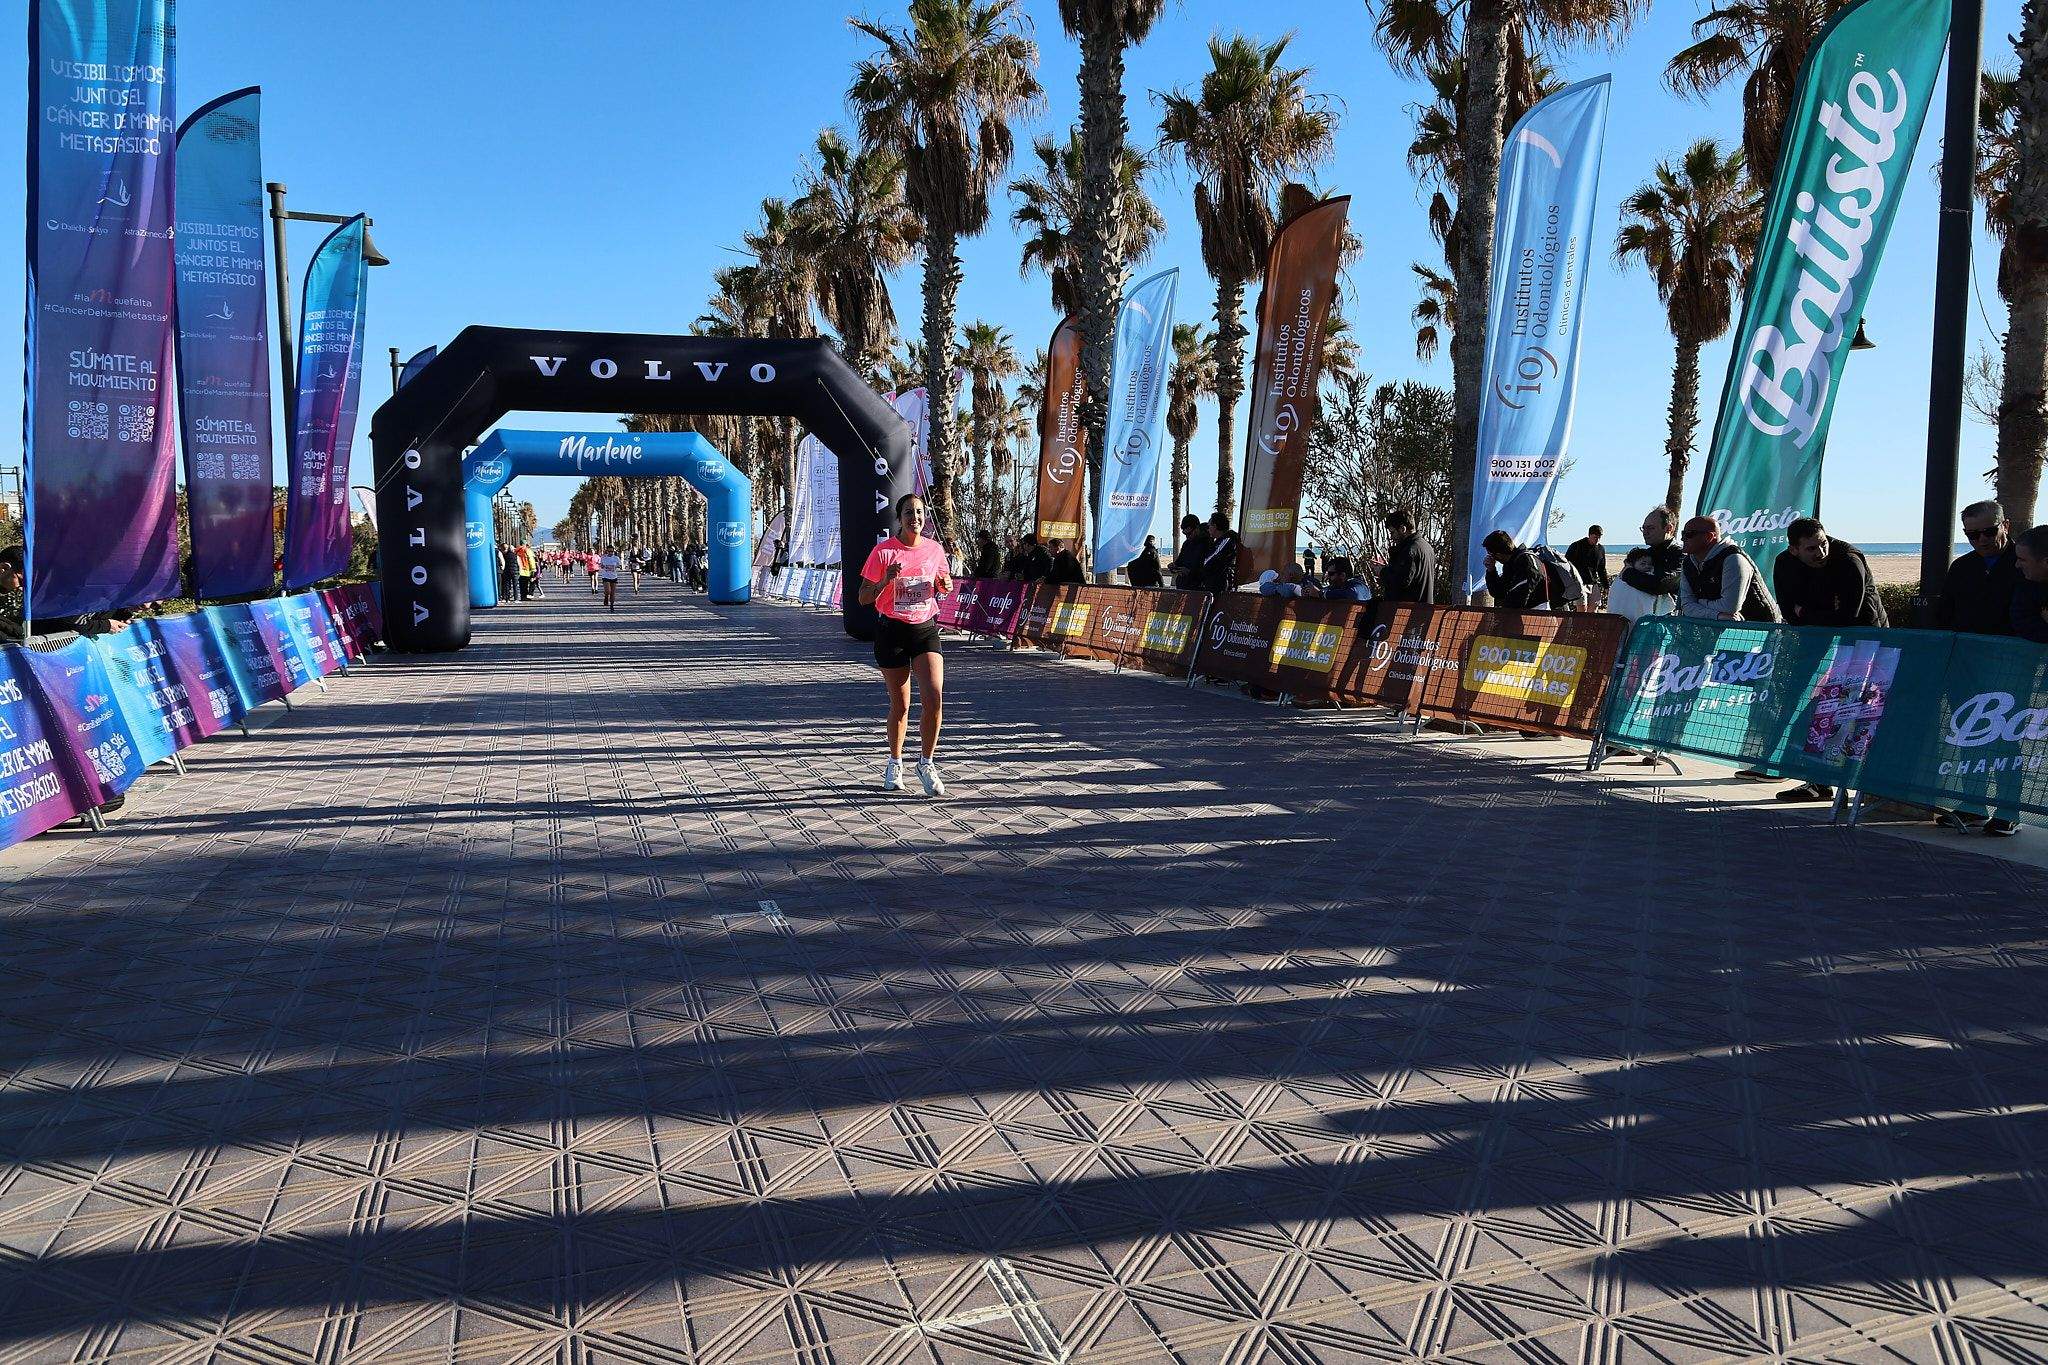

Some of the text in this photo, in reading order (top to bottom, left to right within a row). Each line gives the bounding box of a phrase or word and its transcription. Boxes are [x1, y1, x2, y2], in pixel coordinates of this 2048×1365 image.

[70, 86, 145, 106] JUNTOS EL
[46, 104, 110, 129] CÁNCER
[130, 112, 173, 133] MAMA
[60, 132, 161, 155] METASTÁSICO
[187, 238, 245, 253] JUNTOS EL
[174, 252, 263, 271] CÁNCER DE MAMA
[1565, 236, 1578, 288] dentales
[1739, 67, 1907, 448] Batiste
[182, 269, 256, 286] METASTÁSICO
[1531, 204, 1560, 339] Odontológicos
[1510, 249, 1535, 338] Institutos
[336, 321, 348, 330] EL
[304, 341, 350, 354] METASTÁSIC
[1286, 289, 1312, 398] Odontológicos
[69, 347, 157, 375] SÚMATE AL
[529, 356, 776, 383] VOLVO
[1270, 324, 1290, 397] Institutos
[69, 371, 156, 392] MOVIMIENTO
[1136, 345, 1152, 424] Odontológicos
[1124, 370, 1138, 423] Institutos
[196, 415, 256, 433] SÚMATE AL
[1055, 391, 1069, 443] Institutos
[196, 433, 257, 445] MOVIMIENTO
[303, 448, 327, 461] SÚMA
[558, 436, 642, 471] Marlene
[1491, 459, 1555, 468] 900 131 002
[1491, 469, 1554, 478] www.ioa.es
[1709, 505, 1801, 535] Batiste
[404, 449, 429, 627] VOLVO
[1752, 538, 1766, 547] EN
[956, 588, 978, 610] renfe
[988, 591, 1013, 614] renfe
[1230, 620, 1259, 634] Institutos
[1280, 627, 1337, 649] 900 131 002
[1227, 632, 1268, 649] Odontológicos
[1397, 634, 1440, 652] Institutos
[1476, 644, 1512, 665] 900
[1540, 652, 1578, 676] 002
[1473, 668, 1570, 697] www.ioa.es
[1638, 646, 1775, 698] Batiste
[1632, 689, 1769, 721] CHAMPÚ EN SECO
